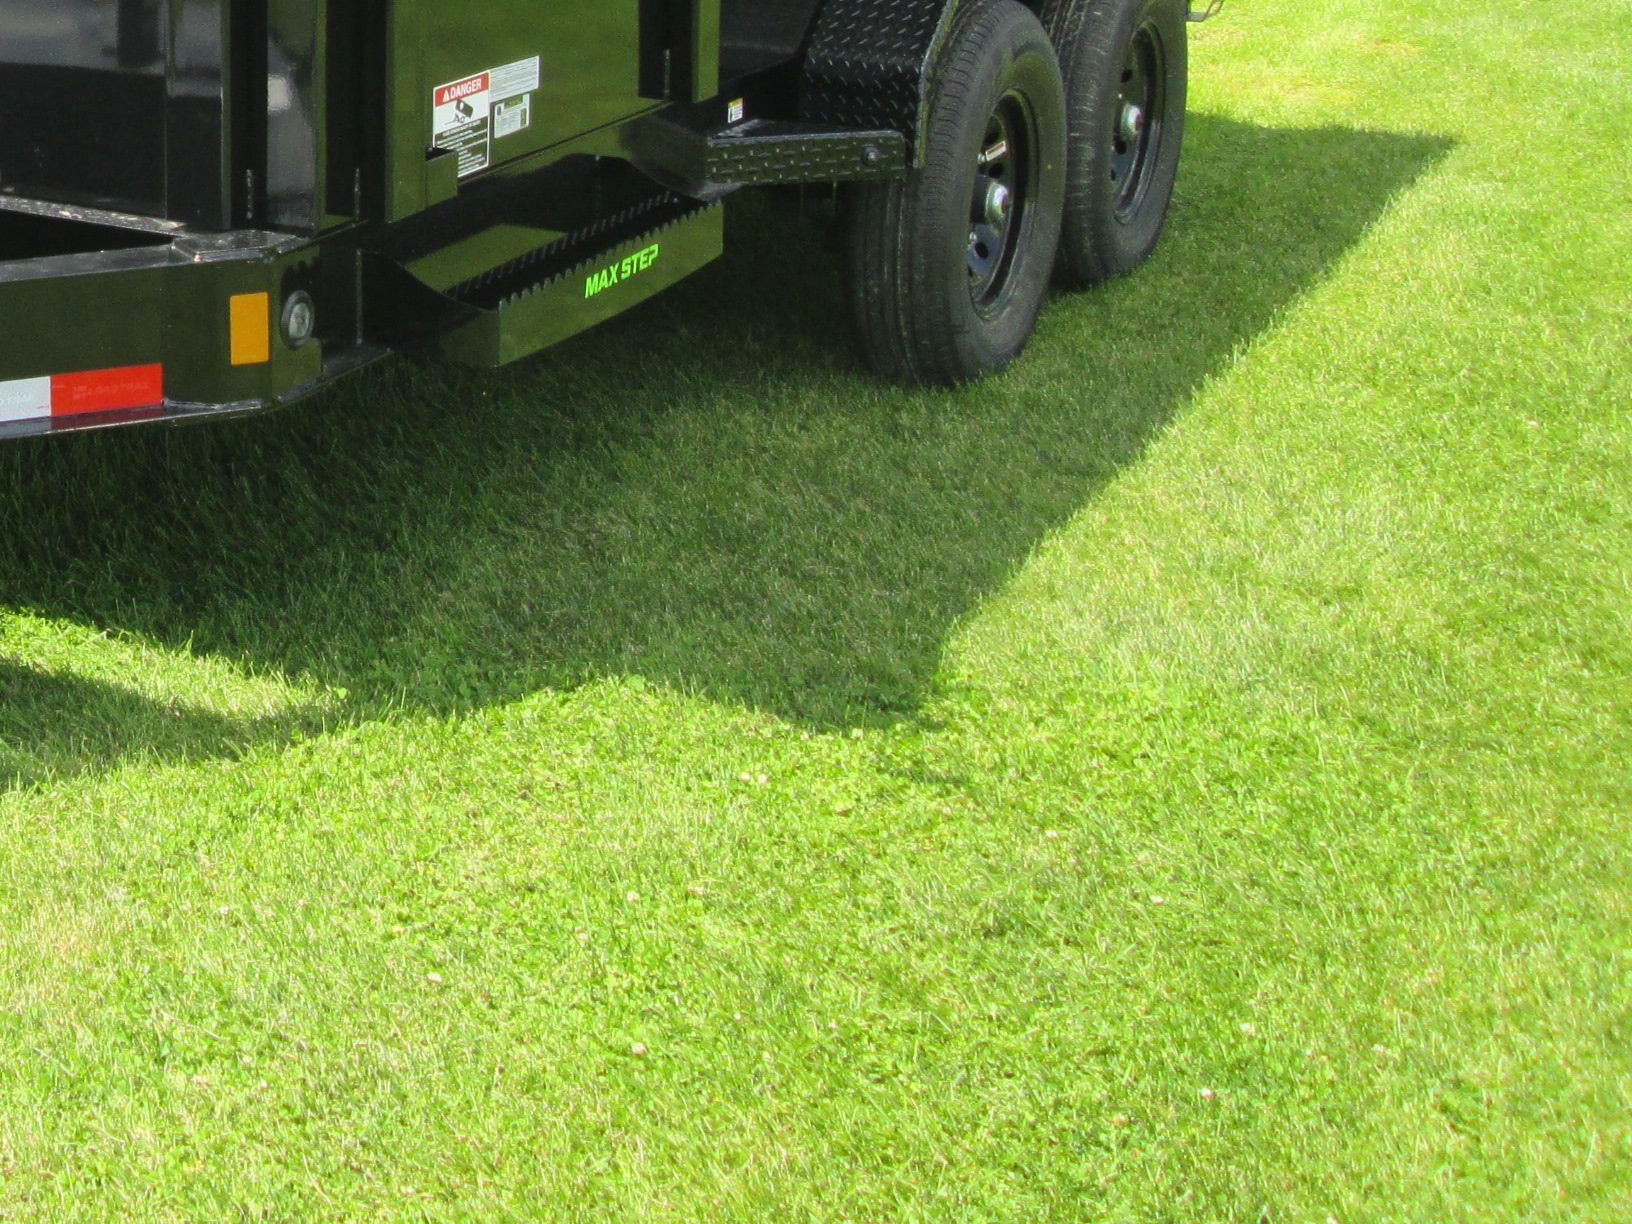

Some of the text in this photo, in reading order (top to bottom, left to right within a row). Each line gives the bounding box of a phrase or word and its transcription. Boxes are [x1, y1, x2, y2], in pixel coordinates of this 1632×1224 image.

[450, 78, 482, 99] DANGER
[585, 243, 659, 299] MAX STEP
